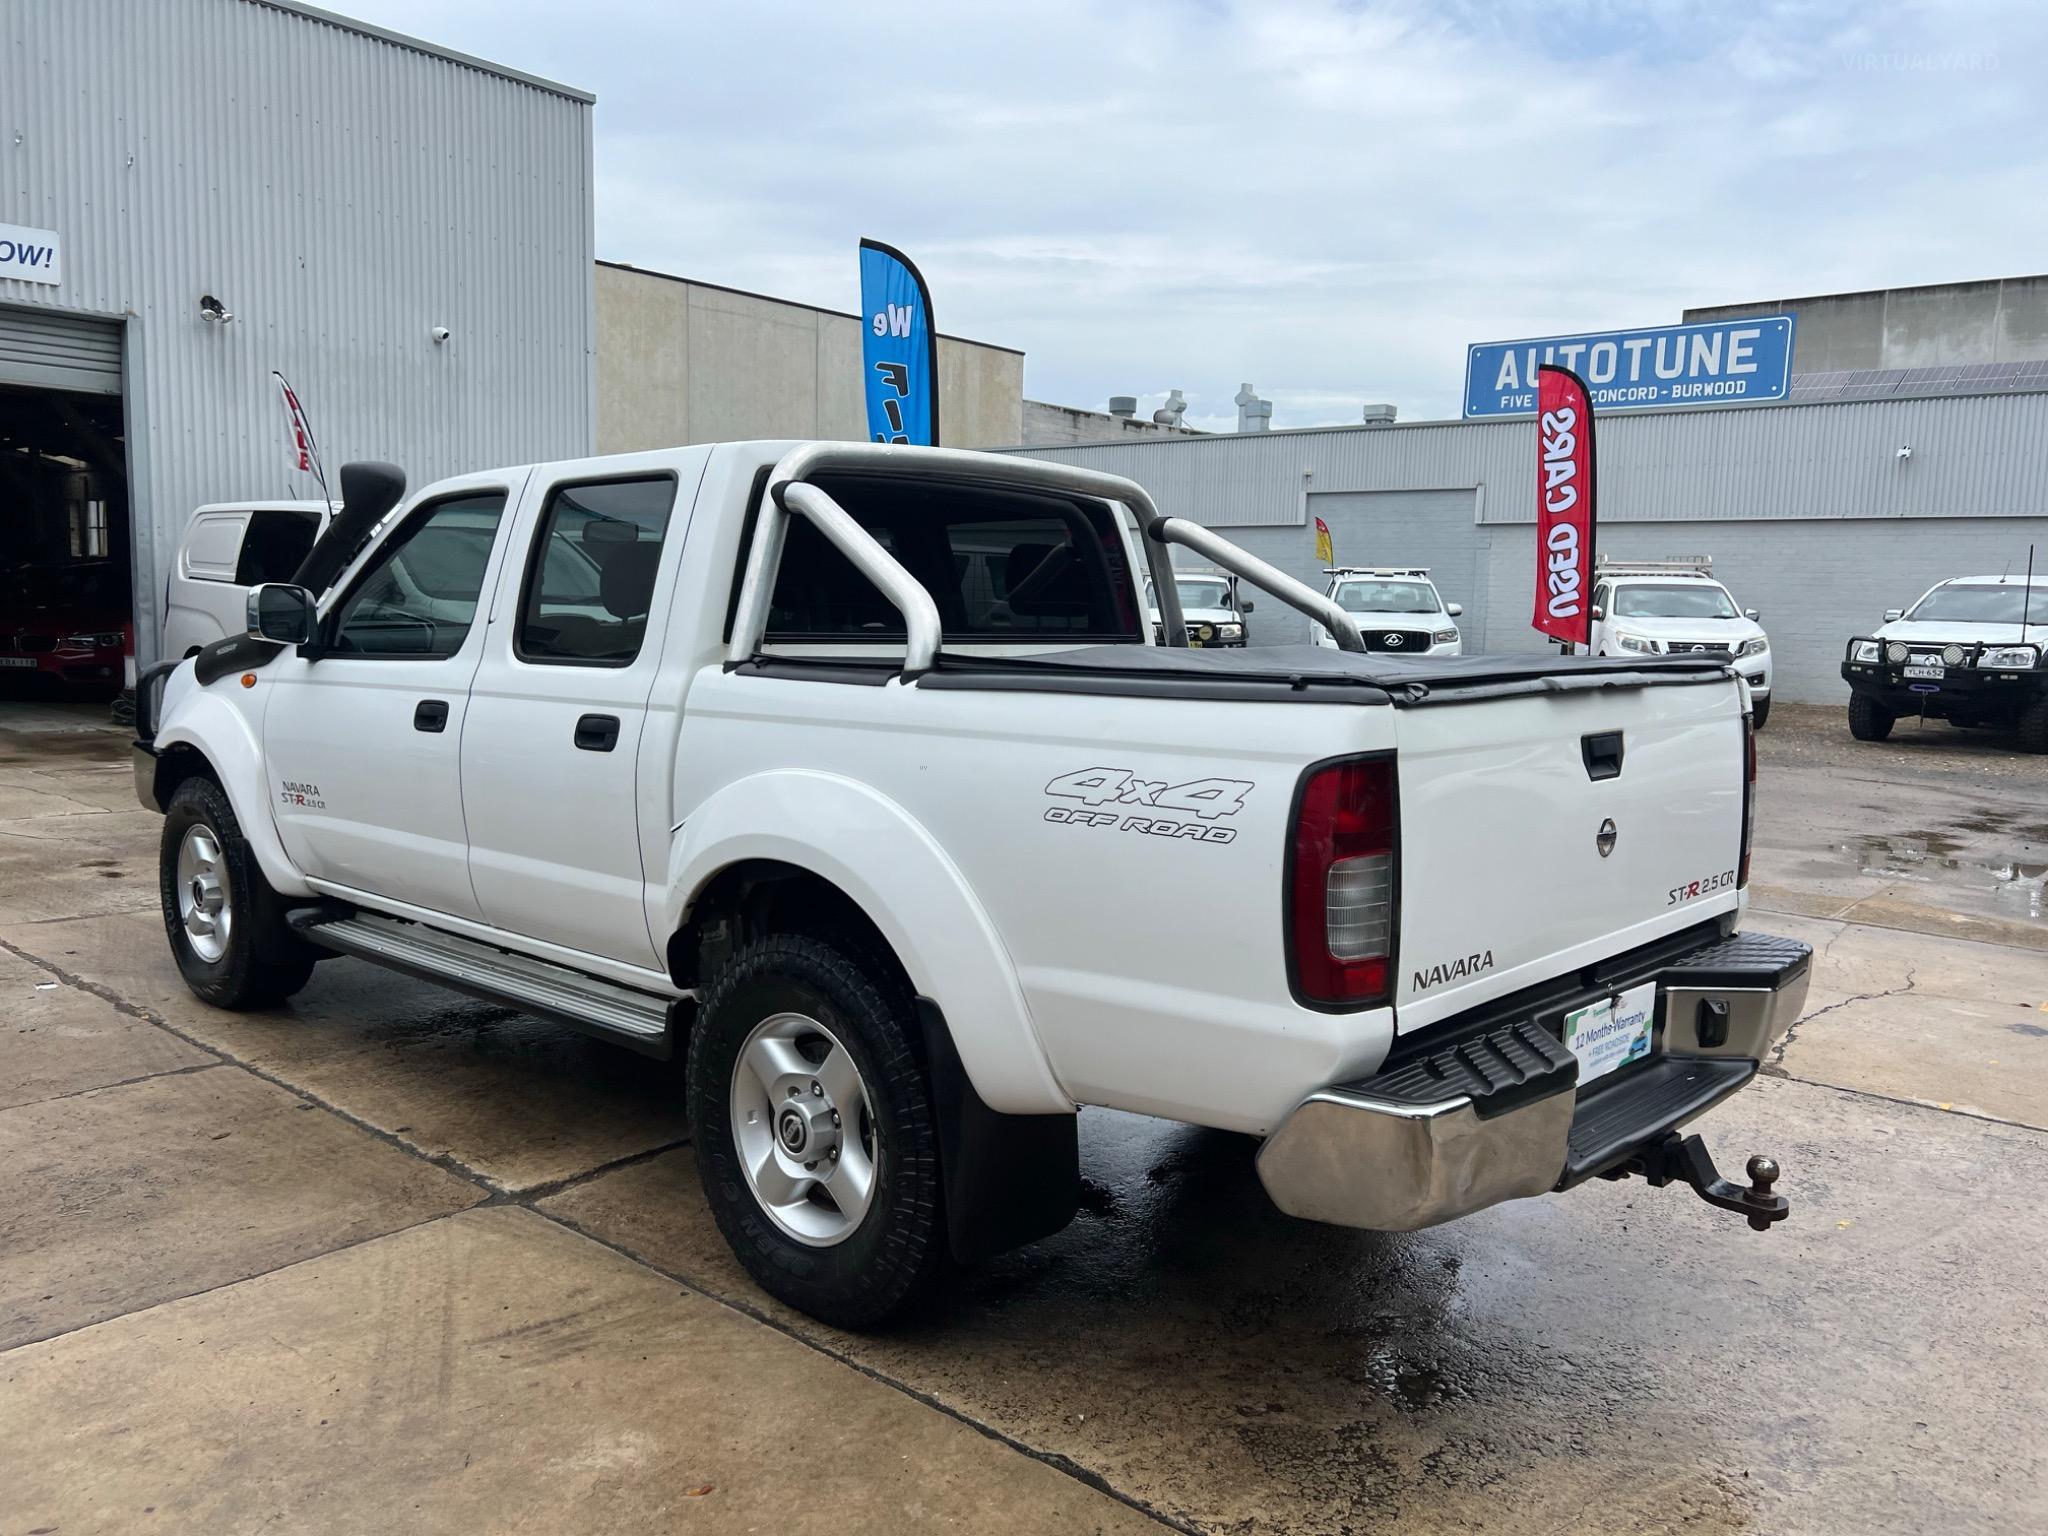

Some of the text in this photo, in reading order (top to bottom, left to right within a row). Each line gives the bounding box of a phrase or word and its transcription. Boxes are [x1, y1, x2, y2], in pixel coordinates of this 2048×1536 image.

[1495, 328, 1761, 391] AUTOTUNE
[1500, 394, 1533, 409] FIVE
[1590, 386, 1658, 404] CONCORD
[1672, 380, 1747, 399] BURWOOD
[282, 780, 321, 798] NAVARA
[1045, 766, 1256, 820] 4x4
[1044, 807, 1237, 844] OFF ROAD
[1667, 869, 1734, 906] ST-R 2.5 CR
[1412, 949, 1494, 993] NAVARA
[1575, 1032, 1585, 1050] 12
[1586, 1023, 1612, 1044] Months
[1613, 1010, 1646, 1032] Warranty
